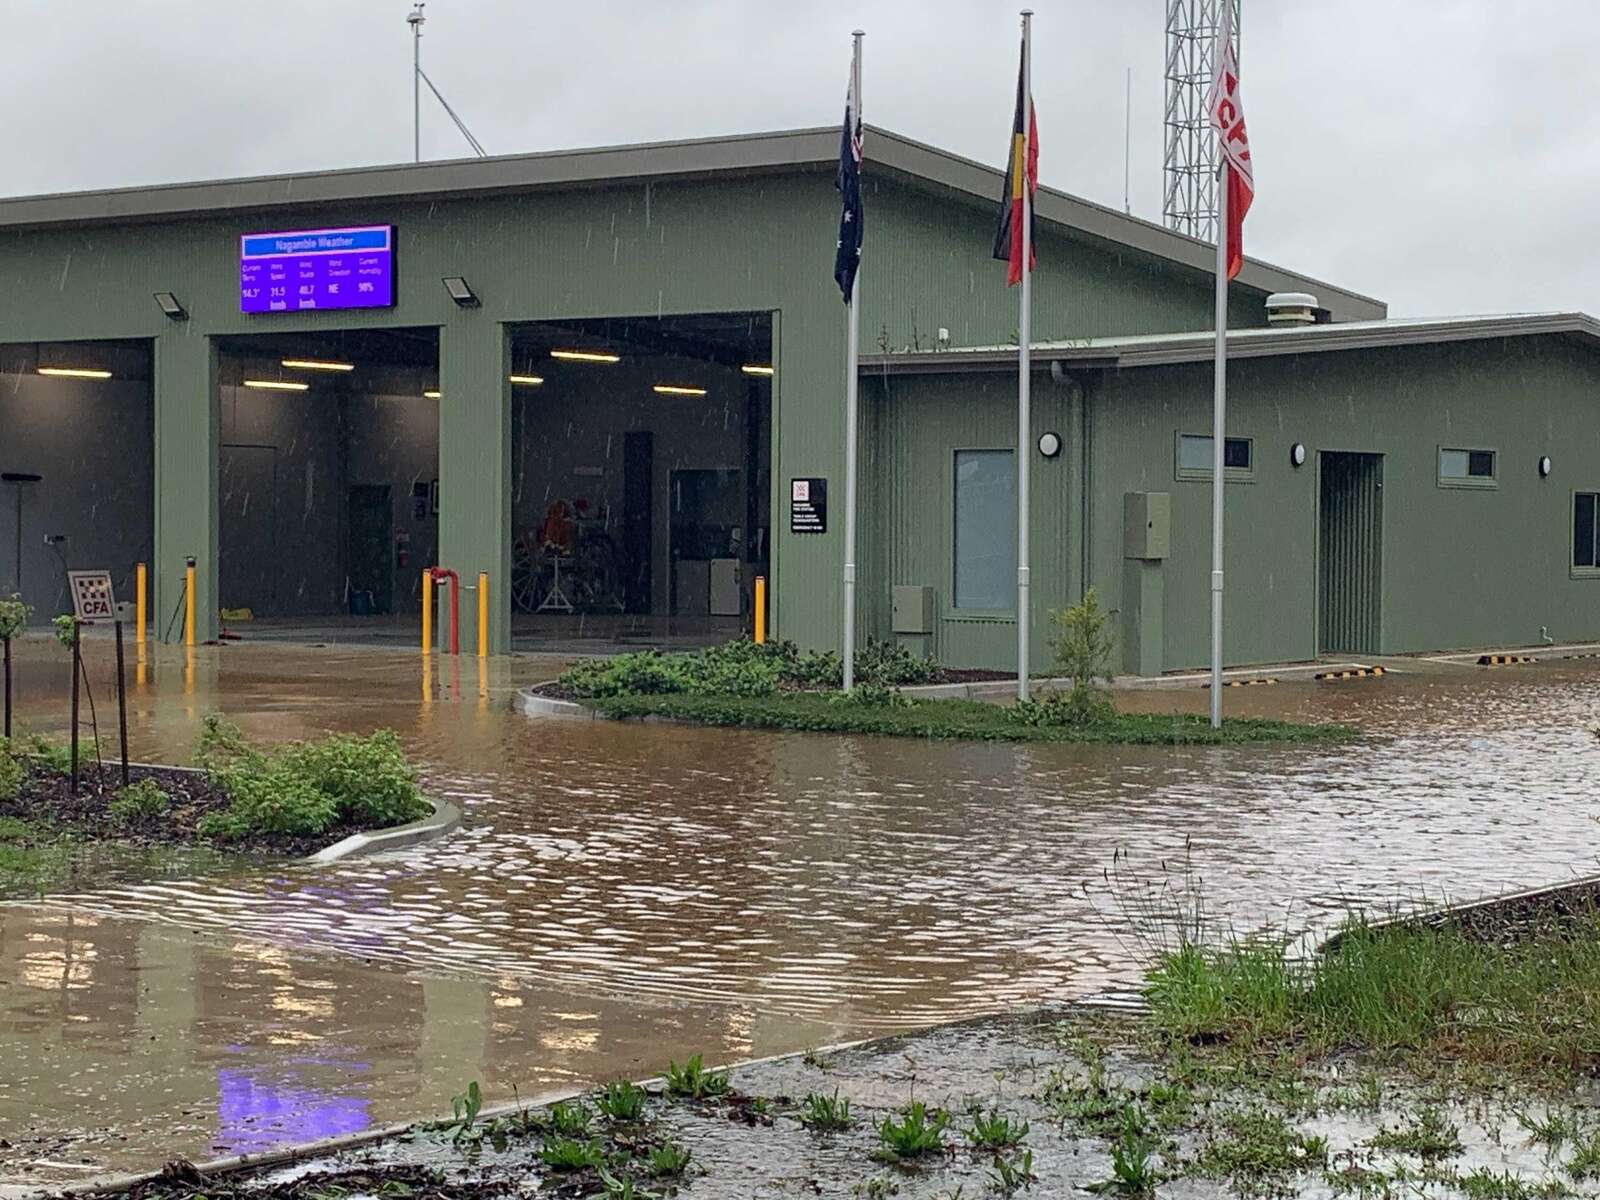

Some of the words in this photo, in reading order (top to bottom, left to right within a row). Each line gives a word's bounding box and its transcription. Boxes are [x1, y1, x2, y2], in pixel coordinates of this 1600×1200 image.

[276, 238, 317, 253] Nagambie
[318, 236, 354, 248] Weather
[83, 601, 109, 614] CFA
